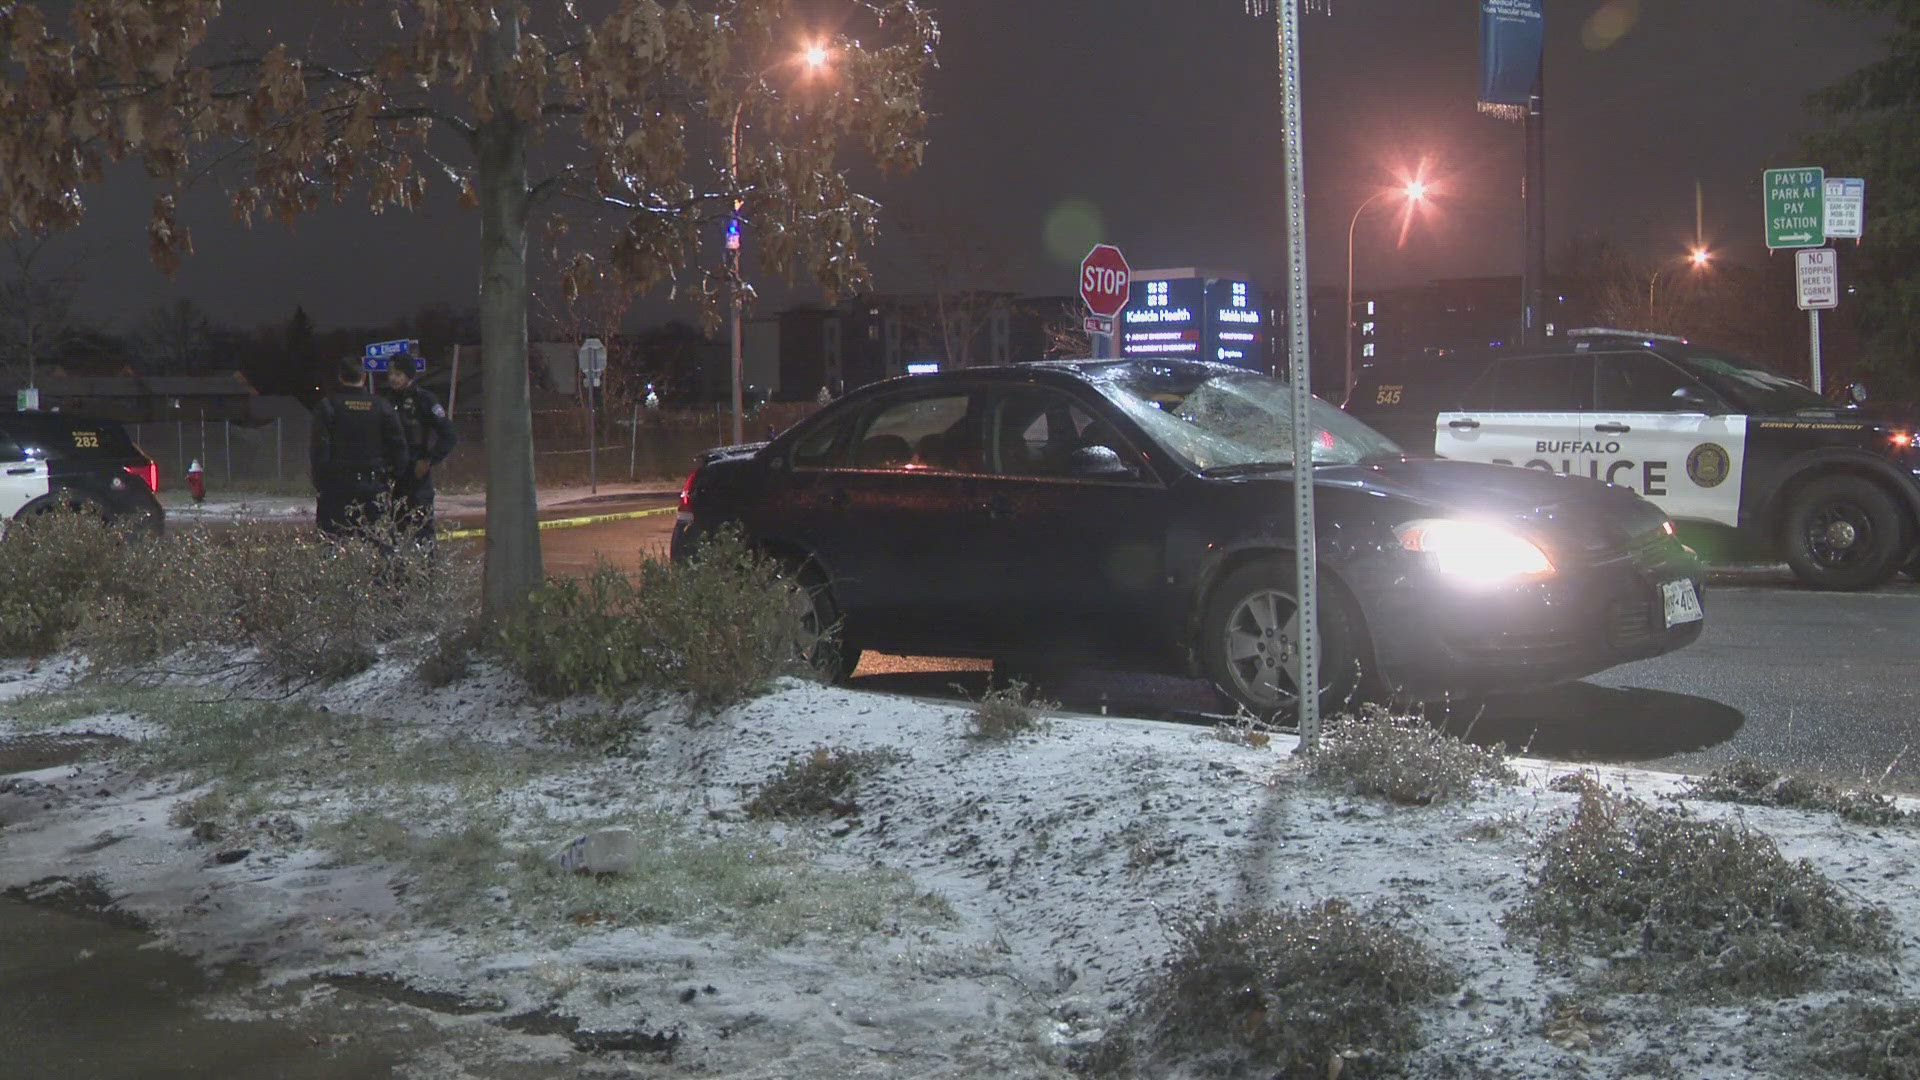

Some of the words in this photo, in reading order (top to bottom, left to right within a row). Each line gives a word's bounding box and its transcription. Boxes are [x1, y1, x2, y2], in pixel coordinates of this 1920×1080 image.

[1775, 173, 1796, 185] PAY
[1800, 172, 1813, 184] TO
[1772, 188, 1800, 200] PARK
[1803, 187, 1816, 199] AT
[1784, 202, 1805, 214] PAY
[1773, 216, 1817, 230] STATION
[1808, 253, 1823, 264] NO
[1800, 266, 1833, 275] STOPPING
[1084, 265, 1126, 296] STOP
[1802, 276, 1820, 285] HERE
[1822, 276, 1832, 284] TO
[1803, 286, 1832, 296] CORNER
[1160, 308, 1190, 321] Health
[1376, 391, 1400, 404] 545
[1811, 423, 1864, 431] COMMUNITY
[75, 436, 99, 448] 282
[1536, 441, 1620, 454] BUFFALO
[1492, 458, 1667, 496] ICE
